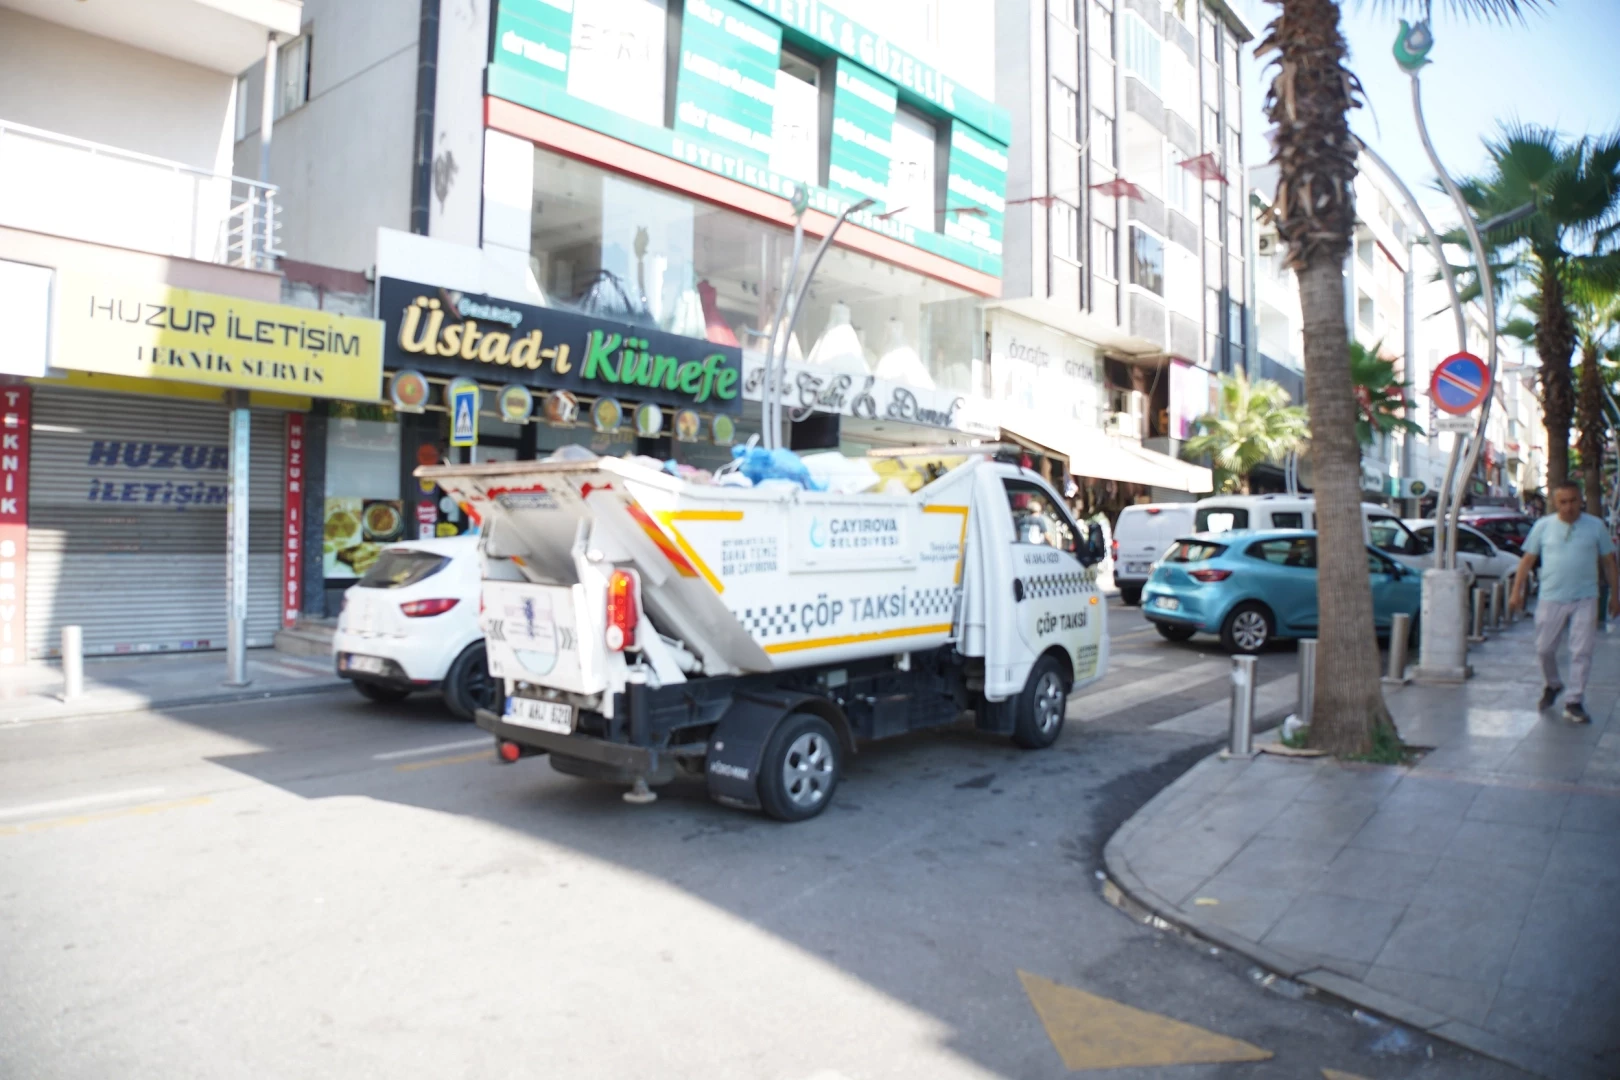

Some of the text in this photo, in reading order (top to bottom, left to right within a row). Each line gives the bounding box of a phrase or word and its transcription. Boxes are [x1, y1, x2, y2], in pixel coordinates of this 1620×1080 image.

[839, 22, 856, 55] &
[89, 295, 361, 358] HUZUR İLETİŞİM
[399, 296, 573, 375] Üstad-ı
[580, 328, 740, 403] Künefe
[242, 358, 326, 385] SERVİS
[88, 441, 229, 470] HUZUR
[88, 478, 229, 513] İLETİŞİM
[829, 517, 899, 535] ÇAYIROVA
[829, 535, 899, 549] BELEDİYESİ
[801, 586, 907, 634] ÇÖP TAKSİ
[1036, 606, 1088, 638] ÇÖP TAKSİ
